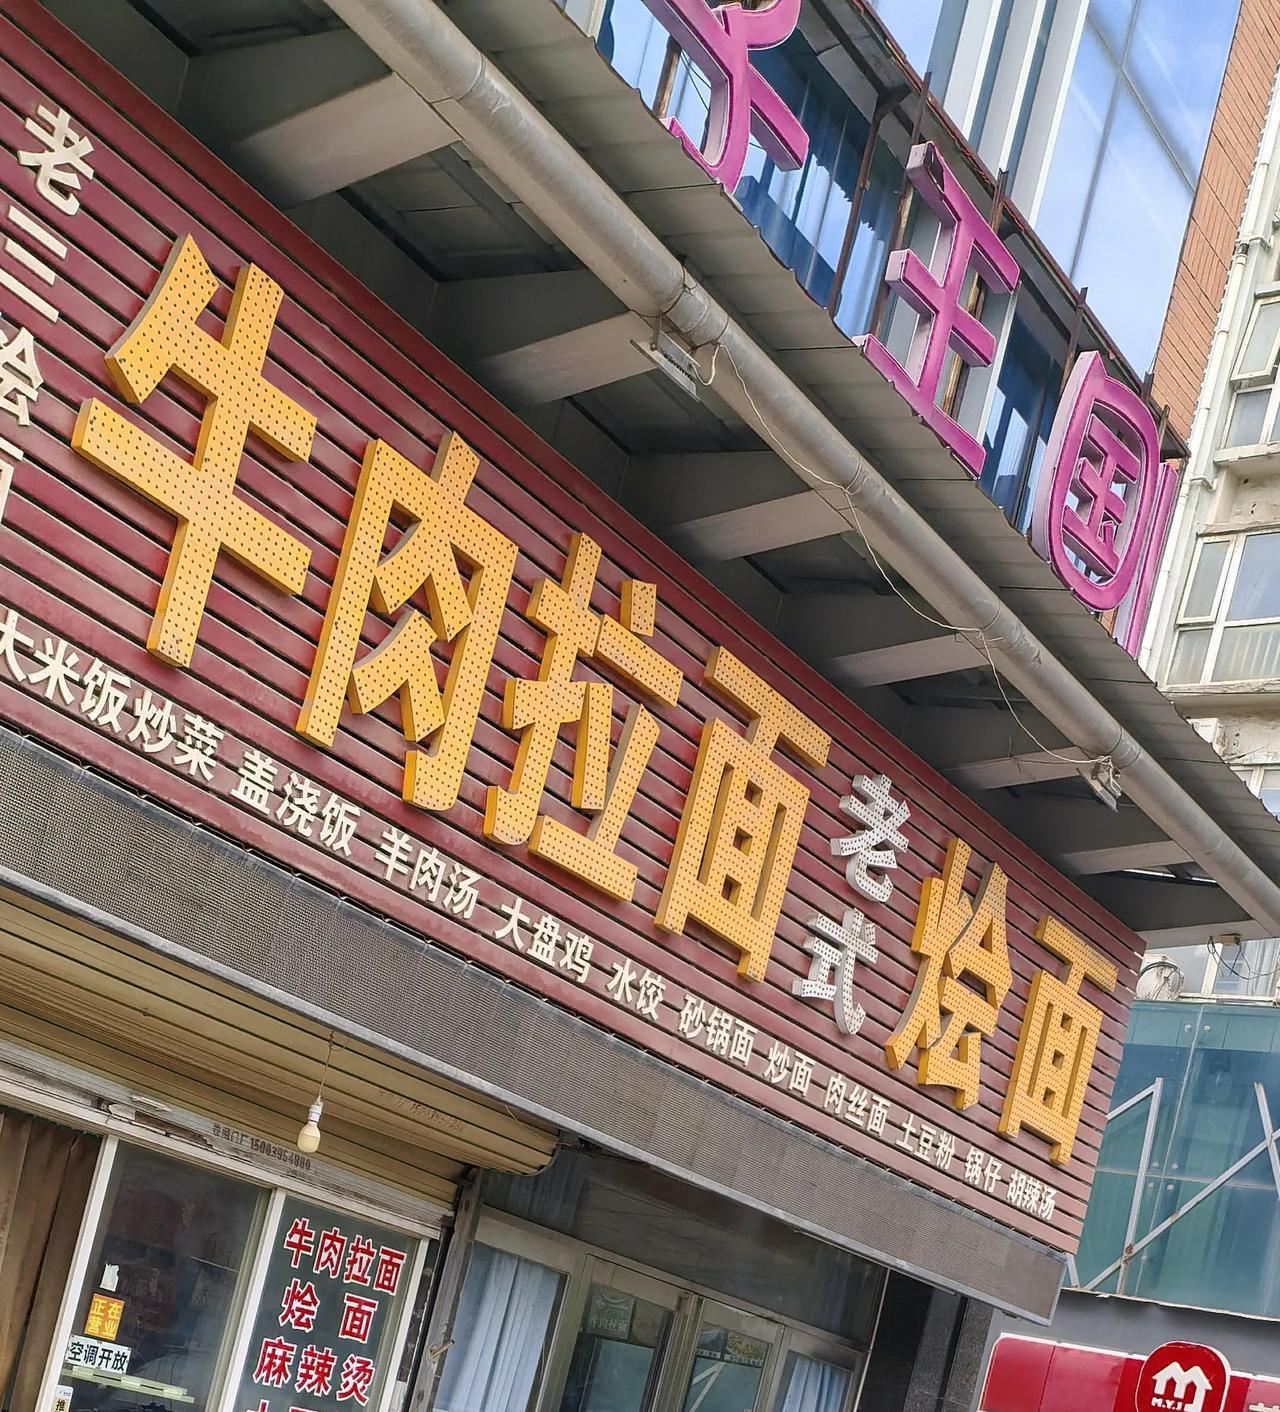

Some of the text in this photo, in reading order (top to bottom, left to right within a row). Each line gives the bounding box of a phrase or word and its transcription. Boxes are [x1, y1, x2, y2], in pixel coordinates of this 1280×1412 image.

[71, 233, 1119, 1166] 牛肉拉面 老式 烩面
[0, 609, 1058, 1221] 大米饭炒菜 盖浇饭 羊肉汤 大盘鸡 水饺 砂锅面 炒面 肉丝面 土豆粉 锅仔 胡辣汤
[284, 1217, 407, 1296] 牛肉拉面
[88, 1315, 119, 1339] 营业
[92, 1298, 122, 1320] 正在
[278, 1278, 378, 1344] 烩面
[67, 1341, 128, 1372] 空调开放
[253, 1336, 375, 1407] 麻辣烫
